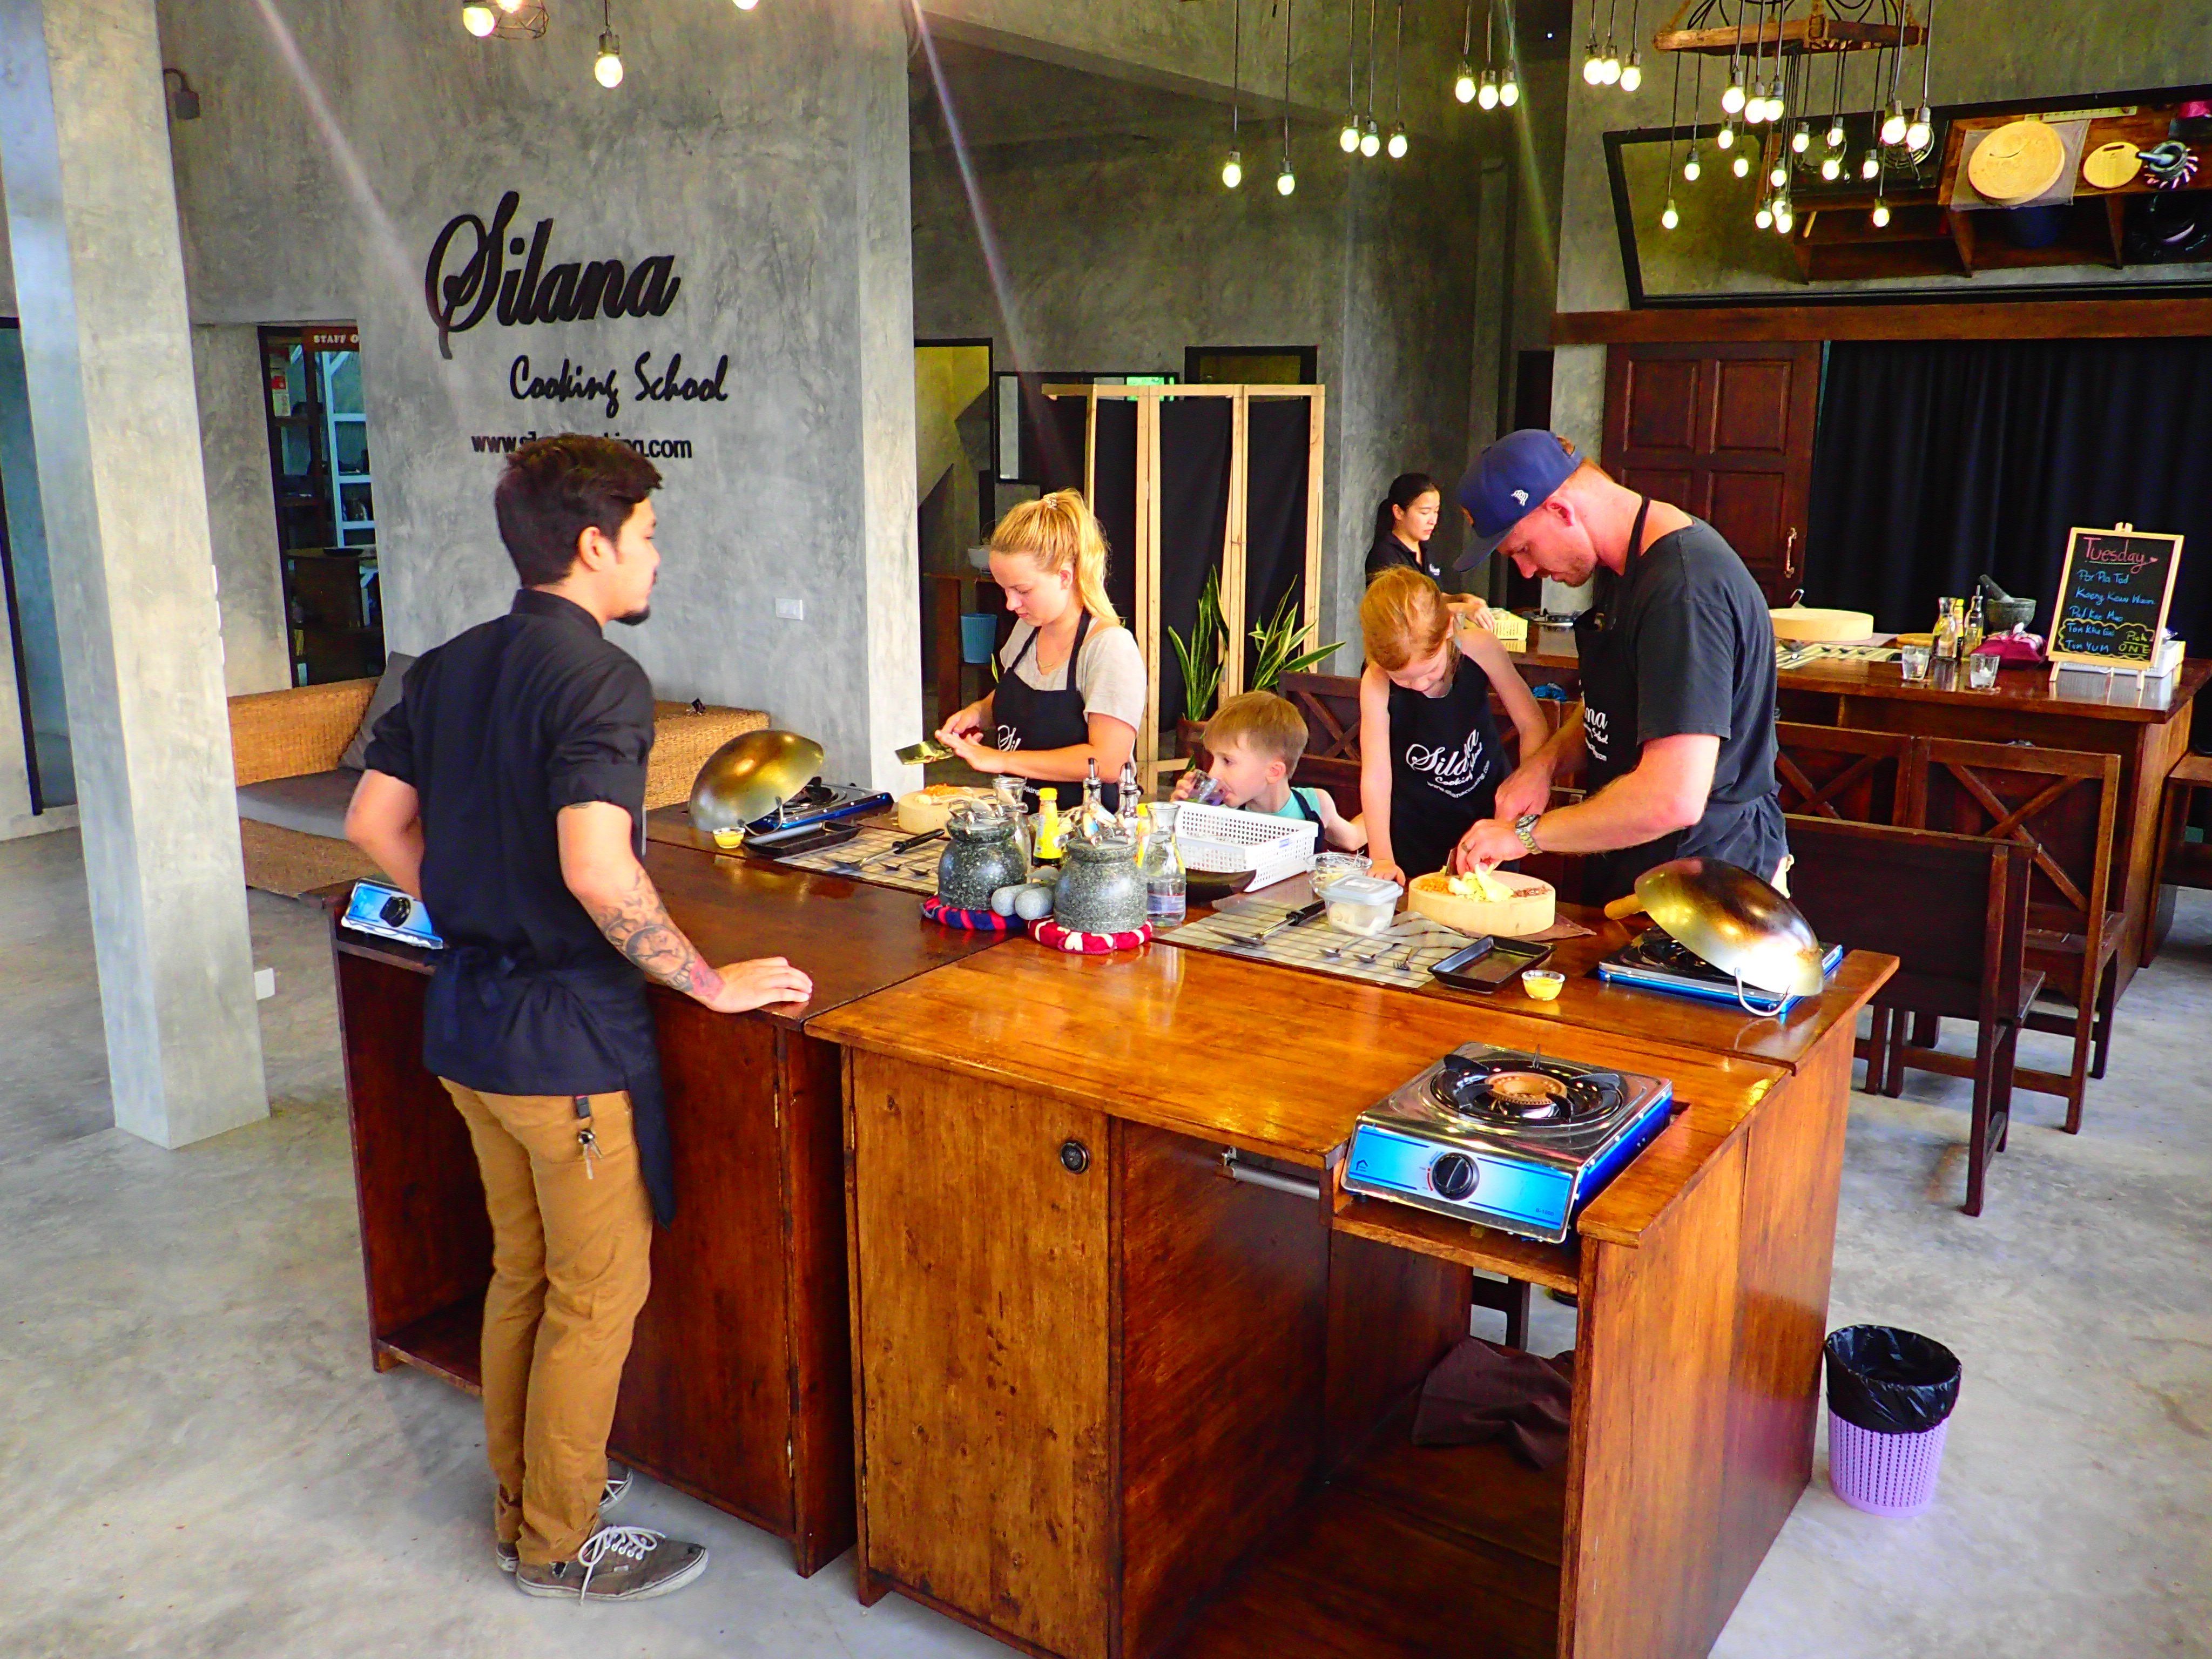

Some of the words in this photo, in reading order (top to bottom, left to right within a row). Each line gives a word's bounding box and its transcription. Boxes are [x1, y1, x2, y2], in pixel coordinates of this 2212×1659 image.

[426, 191, 681, 359] Silana
[313, 334, 346, 343] STAFF
[510, 354, 619, 418] Cooking
[635, 351, 728, 401] School
[2083, 537, 2147, 574] Tuesday
[2119, 643, 2149, 653] ONE
